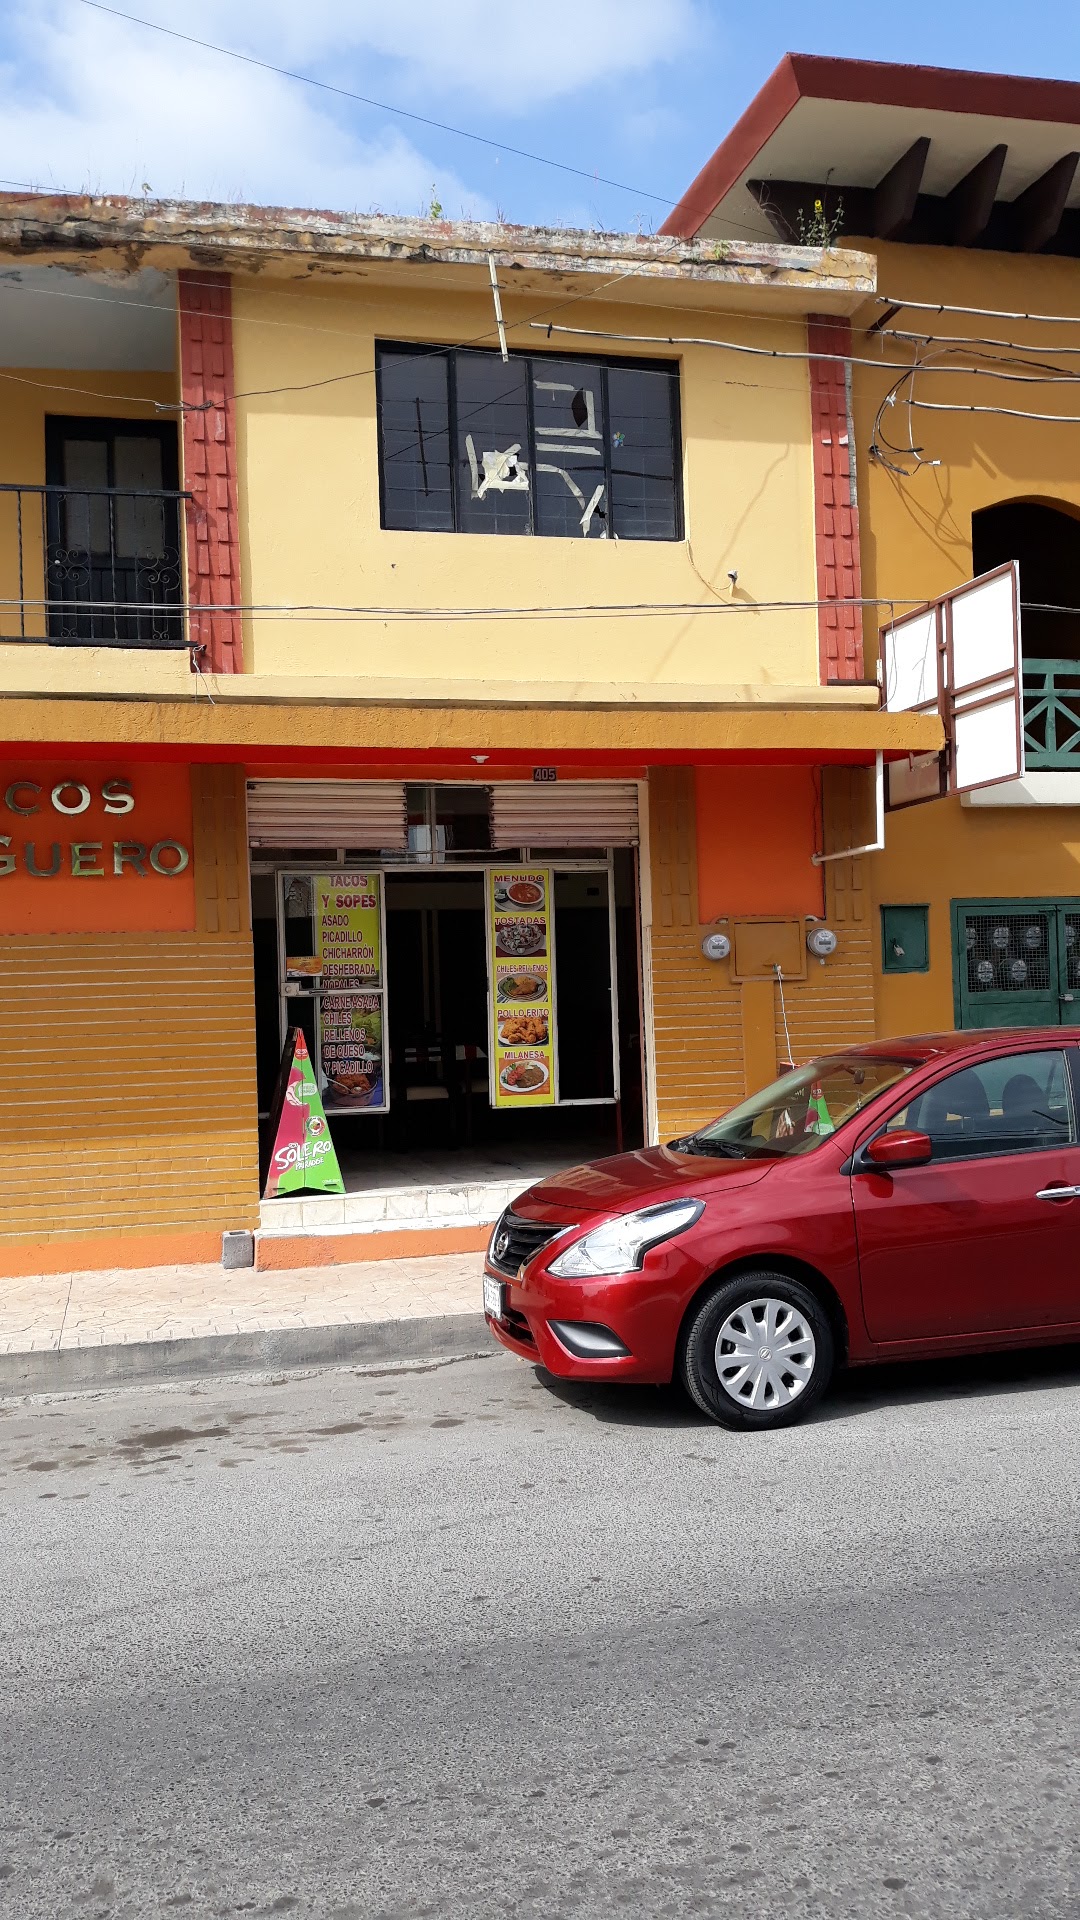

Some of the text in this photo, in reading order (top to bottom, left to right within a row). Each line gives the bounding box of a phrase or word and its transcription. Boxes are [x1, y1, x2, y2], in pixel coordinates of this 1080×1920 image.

[534, 768, 556, 780] 405
[5, 779, 135, 815] COS
[328, 875, 368, 888] TACOS
[321, 894, 377, 909] Y SOPES
[321, 914, 349, 926] ASADO
[495, 917, 546, 925] TOSTADAS
[322, 931, 363, 943] PICADILLO
[322, 944, 374, 959] CHICHARRÓN
[323, 964, 376, 976] DESHEBRADA
[496, 964, 517, 973] CHILES
[323, 994, 379, 1009] CARNE ASADA
[323, 1012, 352, 1025] CHILES
[497, 1008, 550, 1018] POLLO FRITO
[324, 1028, 366, 1042] RELLENOS
[324, 1045, 336, 1058] DE
[337, 1044, 365, 1058] QUESO
[504, 1050, 545, 1060] MILANESA
[323, 1060, 374, 1075] Y PICADILLO
[274, 1140, 332, 1170] SOLERO
